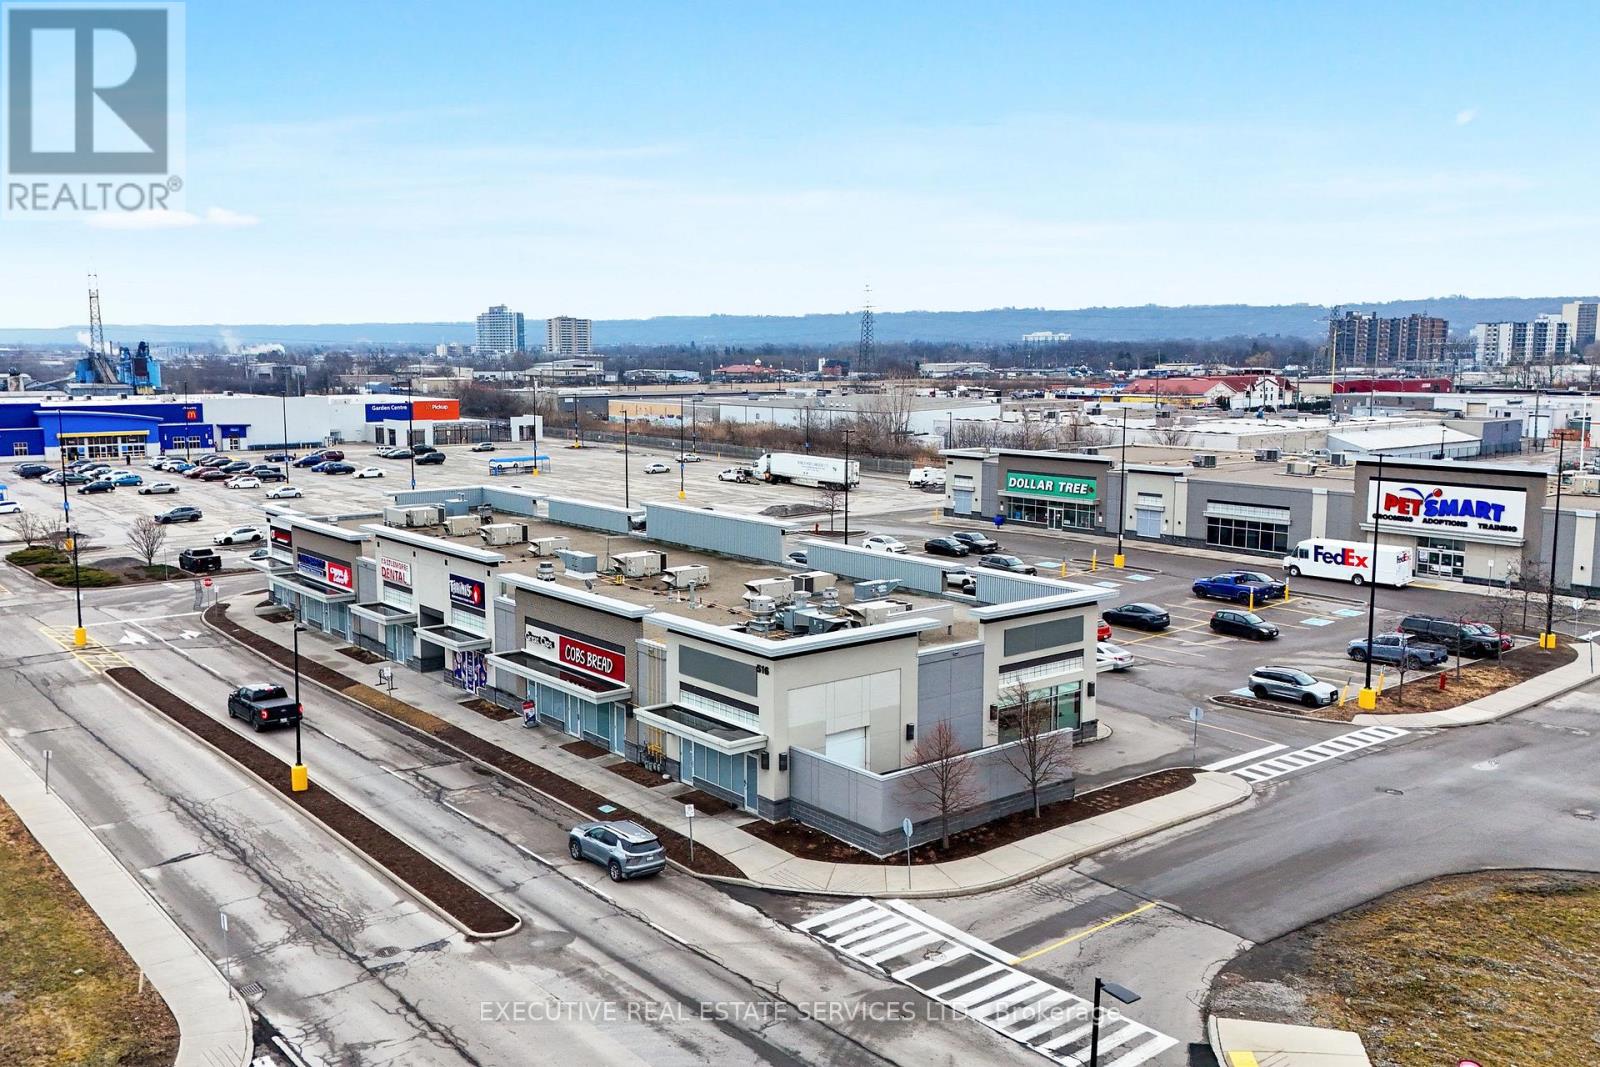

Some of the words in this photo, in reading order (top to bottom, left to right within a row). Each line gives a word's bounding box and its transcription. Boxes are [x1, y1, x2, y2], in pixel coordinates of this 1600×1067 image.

[1008, 477, 1054, 491] DOLLAR
[1058, 481, 1089, 495] TREE
[1372, 512, 1414, 523] GROOMING
[1421, 517, 1469, 528] ADOPTIONS
[1477, 522, 1518, 533] TRAINING
[1313, 544, 1369, 569] FedEx
[381, 566, 409, 585] DENTAL
[564, 644, 585, 665] COBS
[586, 651, 614, 674] BREAD
[756, 664, 770, 676] 516
